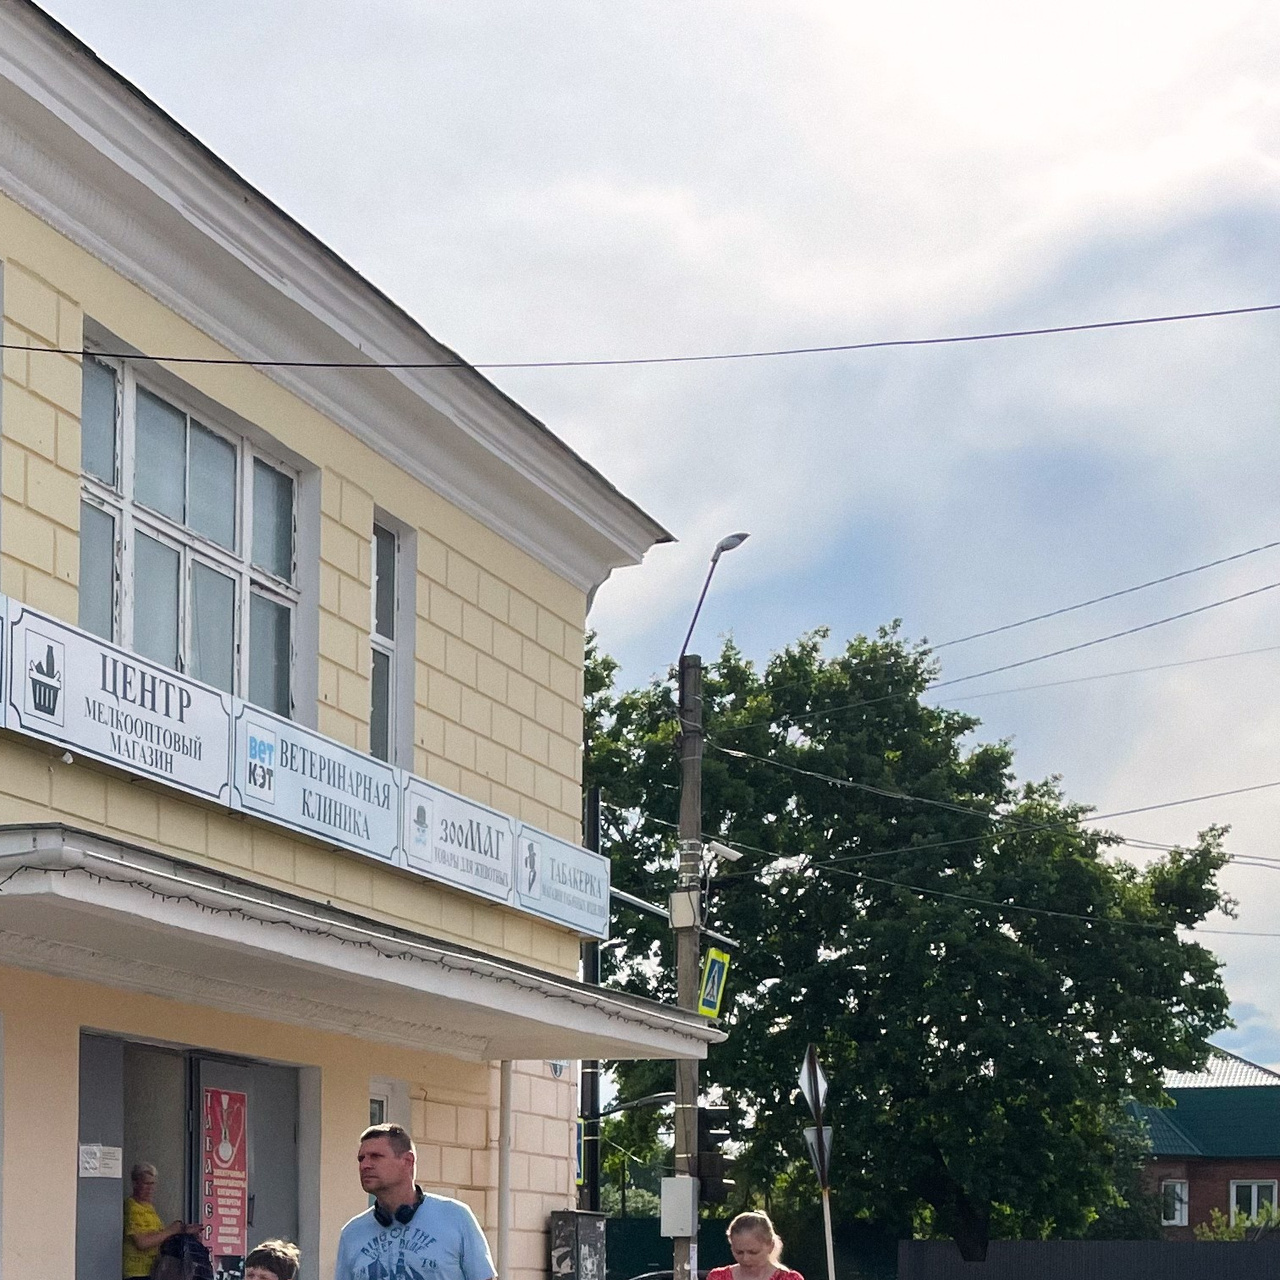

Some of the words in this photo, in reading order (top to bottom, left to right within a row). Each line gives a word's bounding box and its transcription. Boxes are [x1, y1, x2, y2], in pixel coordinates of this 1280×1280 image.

[100, 652, 192, 724] ЦЕНТР
[84, 696, 202, 761] МЕЛКООПТОВЫЙ
[110, 732, 174, 774] МАГАЗИН
[280, 738, 391, 810] ВЕТЕРИНАРНАЯ
[302, 787, 370, 840] КЛИНИКА
[434, 847, 459, 870] ТОВАРЫ
[460, 857, 474, 875] ДЛЯ
[474, 862, 509, 888] ЖИВОТНЫХ
[549, 857, 602, 900] ТАБАКЕРКА
